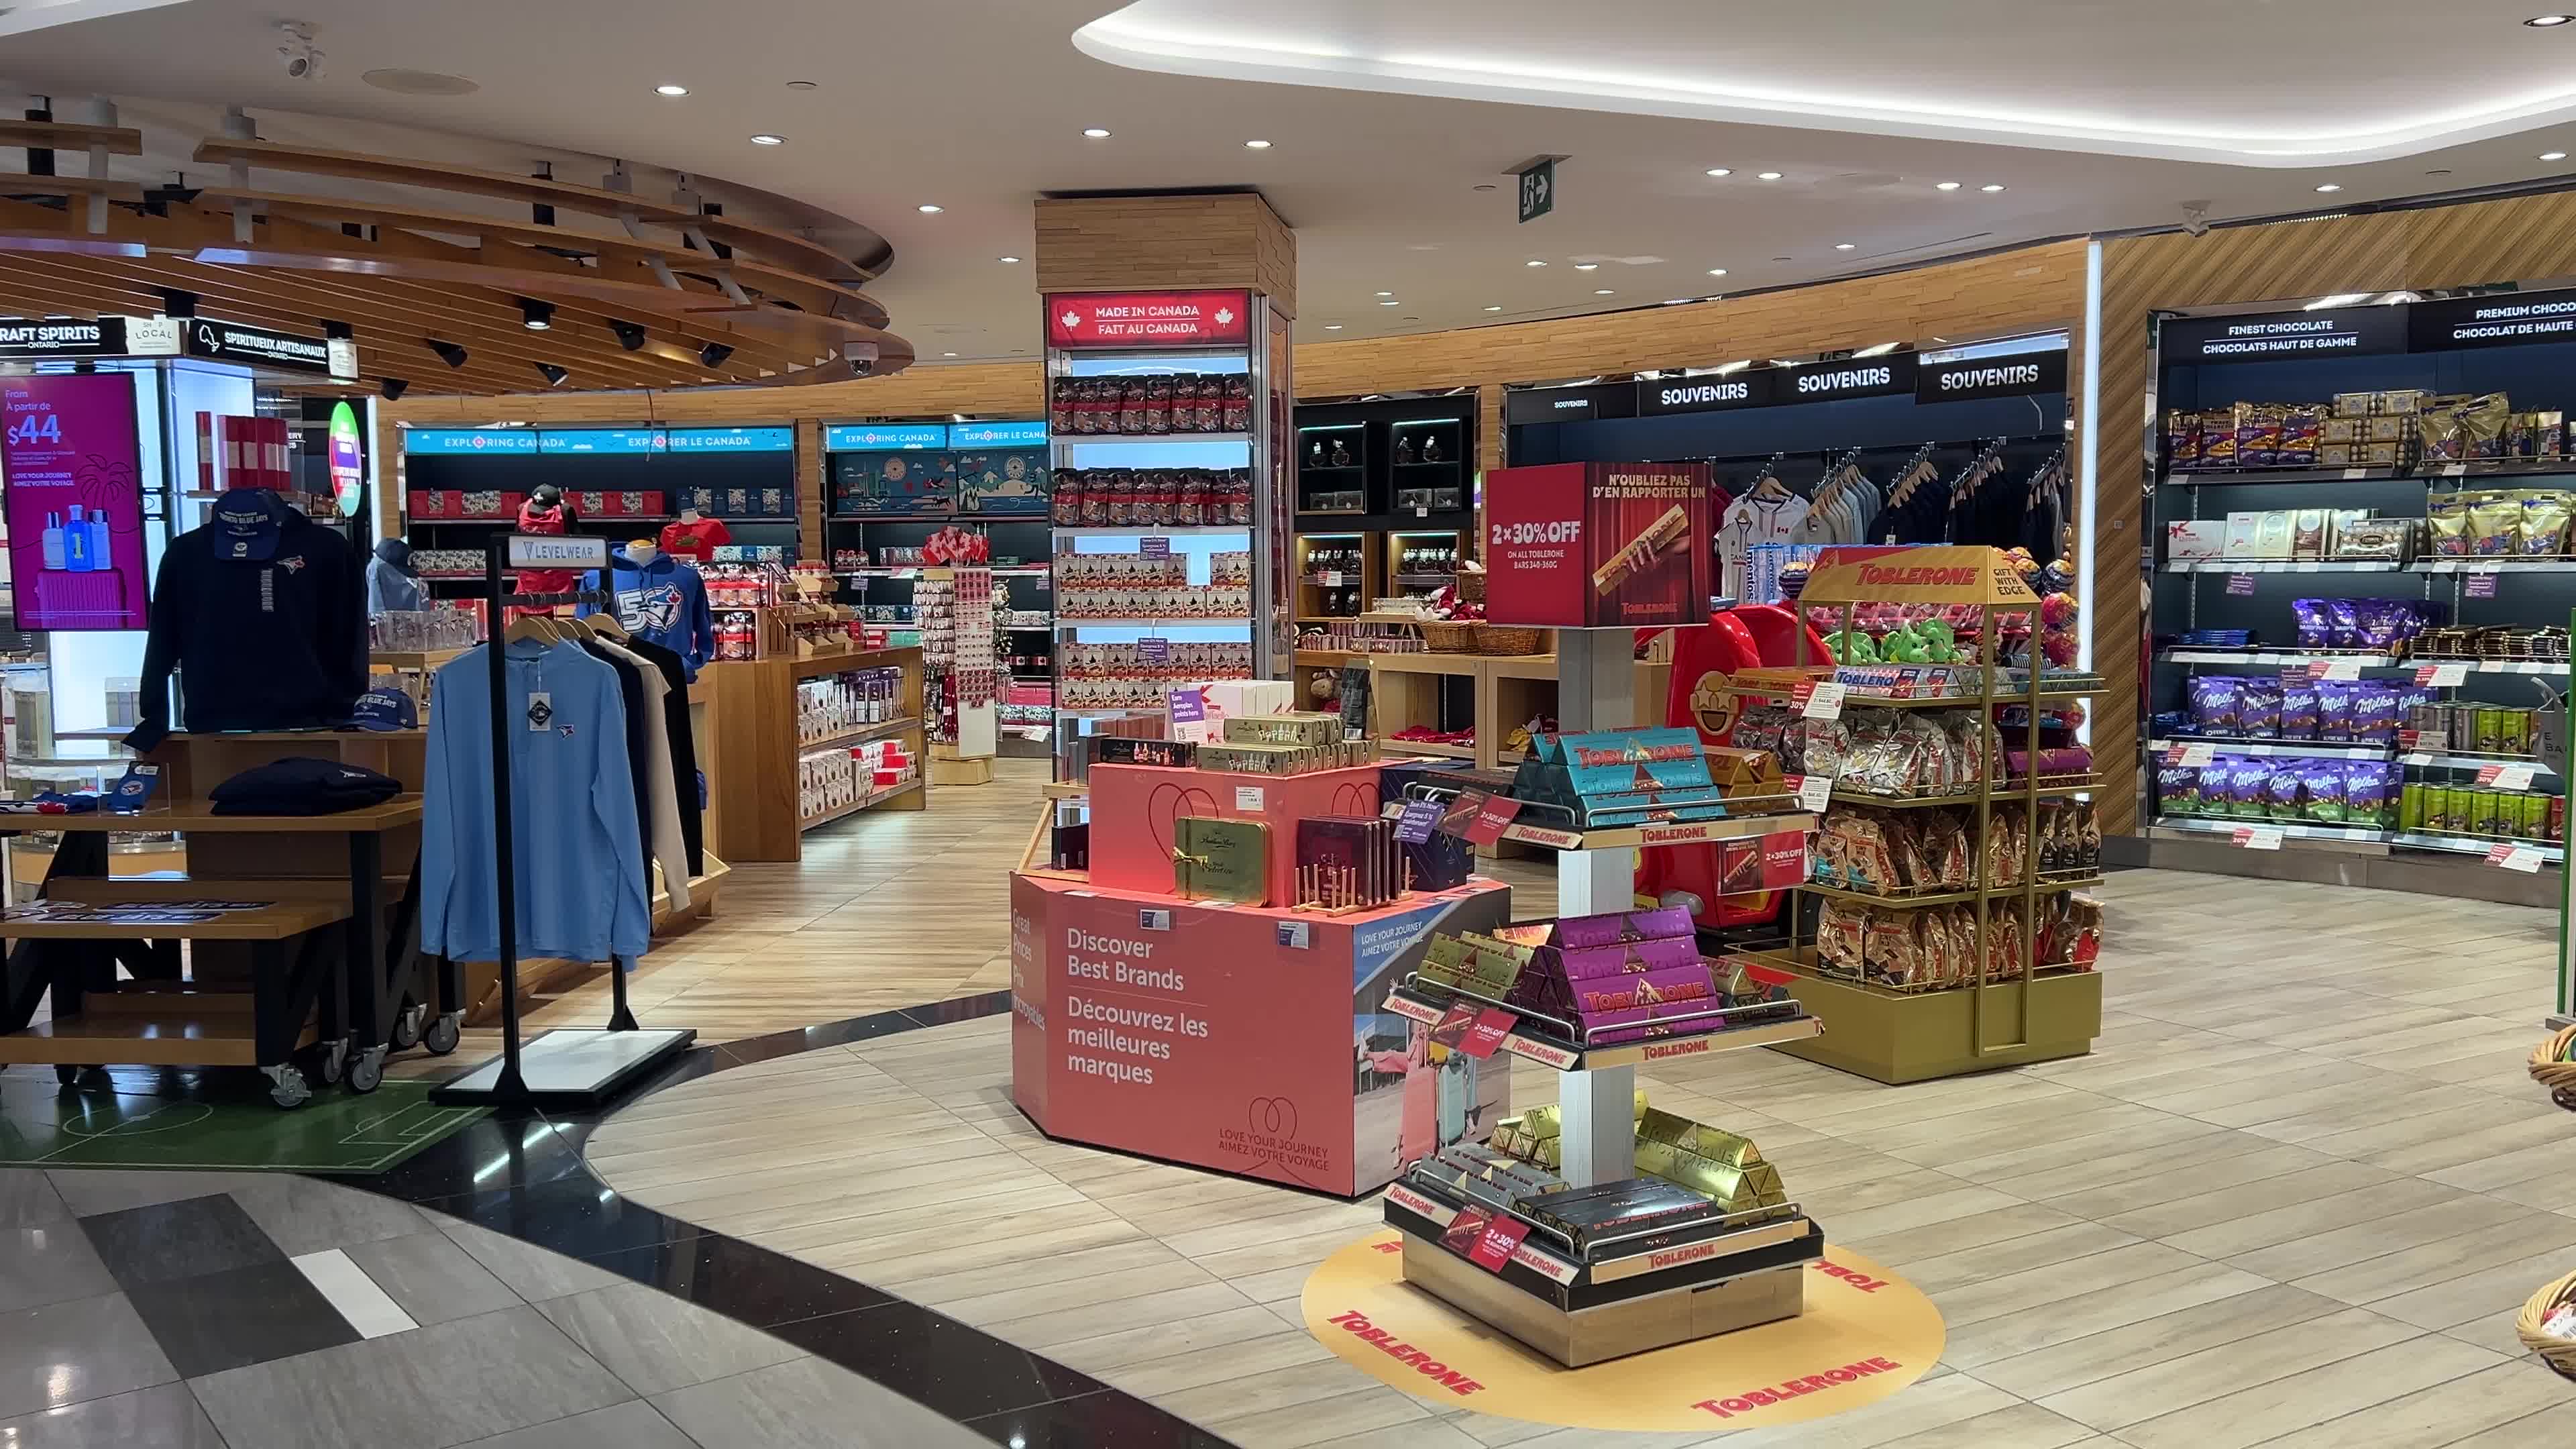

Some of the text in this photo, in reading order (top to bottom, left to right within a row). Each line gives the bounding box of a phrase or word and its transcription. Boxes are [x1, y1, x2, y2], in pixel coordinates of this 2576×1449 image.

[1095, 305, 1199, 317] MADE IN CANADA
[2475, 307, 2529, 320] PREMIUM
[38, 325, 100, 341] SPIRITS
[135, 329, 172, 339] LOCAL
[1098, 323, 1197, 334] FAIT AU CANADA
[2229, 320, 2334, 335] FINEST CHOCOLATE
[2453, 321, 2574, 339] CHOCOLAT DE HAUTE
[27, 341, 60, 349] ONTARIO
[224, 331, 327, 358] SPIRITUEUX ARTISANAUX
[2202, 337, 2357, 355] CHOCOLATS HAUT DE GAMME
[1798, 367, 1890, 393] SOUVENIRS
[1941, 364, 2039, 391] SOUVENIRS
[5, 390, 28, 398] From
[1661, 382, 1748, 405] SOUVENIRS
[40, 402, 51, 411] de
[1554, 399, 1588, 409] SOUVENIRS
[445, 437, 566, 447] EXPLORING CANADA
[628, 436, 751, 447] EXPORER LE CANADA
[845, 433, 935, 443] EXPLORING CANADA
[965, 431, 1009, 441] EXPLORER
[1011, 431, 1020, 439] LE
[1609, 474, 1690, 486] N'OUBLIEZ PAS
[1592, 486, 1706, 498] D'EN RAPPORTER UN
[1548, 520, 1581, 543] OFF
[535, 545, 594, 559] LEVELWEAR
[1527, 549, 1564, 558] TOBLERONE
[1513, 561, 1529, 569] BARS
[1994, 568, 2011, 576] GIFT
[1856, 564, 1980, 586] TOBLERONE
[1994, 577, 2017, 586] WITH
[1997, 586, 2025, 596] EDGE
[2242, 694, 2280, 711] Milka
[2282, 694, 2314, 711] Milka
[2318, 694, 2348, 713] Milk
[2355, 694, 2396, 714] Milka
[2398, 693, 2426, 710] ilka
[2157, 767, 2195, 784] Milka
[2199, 767, 2228, 786] Milk
[2233, 768, 2269, 787] Milka
[2305, 773, 2341, 790] Milka
[2347, 774, 2380, 792] Milka
[1515, 827, 1571, 845] TOBLERONE
[1640, 826, 1707, 841] TOBLERONE
[1790, 848, 1803, 857] OFF
[1013, 908, 1030, 935] Great
[1361, 921, 1422, 945] LOVE YOUR JOURNEY
[1013, 933, 1032, 962] Prices
[1067, 928, 1153, 959] Discover
[1361, 945, 1380, 957] AIMEZ
[1380, 939, 1400, 953] VOTRE
[1067, 955, 1185, 991] Best Brands
[1068, 996, 1208, 1038] Découvrez les
[1389, 996, 1437, 1021] TOBLERONE
[1068, 1028, 1171, 1060] meilleures
[1513, 1038, 1568, 1065] TOBLERONE
[1642, 1039, 1709, 1061] TOBLERONE
[1068, 1054, 1153, 1085] marques
[1219, 1128, 1328, 1159] LOVE YOUR JOURNEY
[1219, 1140, 1330, 1171] AIMEZ VOTRE VOYAGE
[1388, 1185, 1436, 1216] TOBLERONE
[1514, 1248, 1564, 1279] OBLERONE
[1648, 1244, 1715, 1269] TOBLERONE
[1326, 1309, 1485, 1397] TOBLERONE
[1690, 1355, 1903, 1419] TOBLERONE
